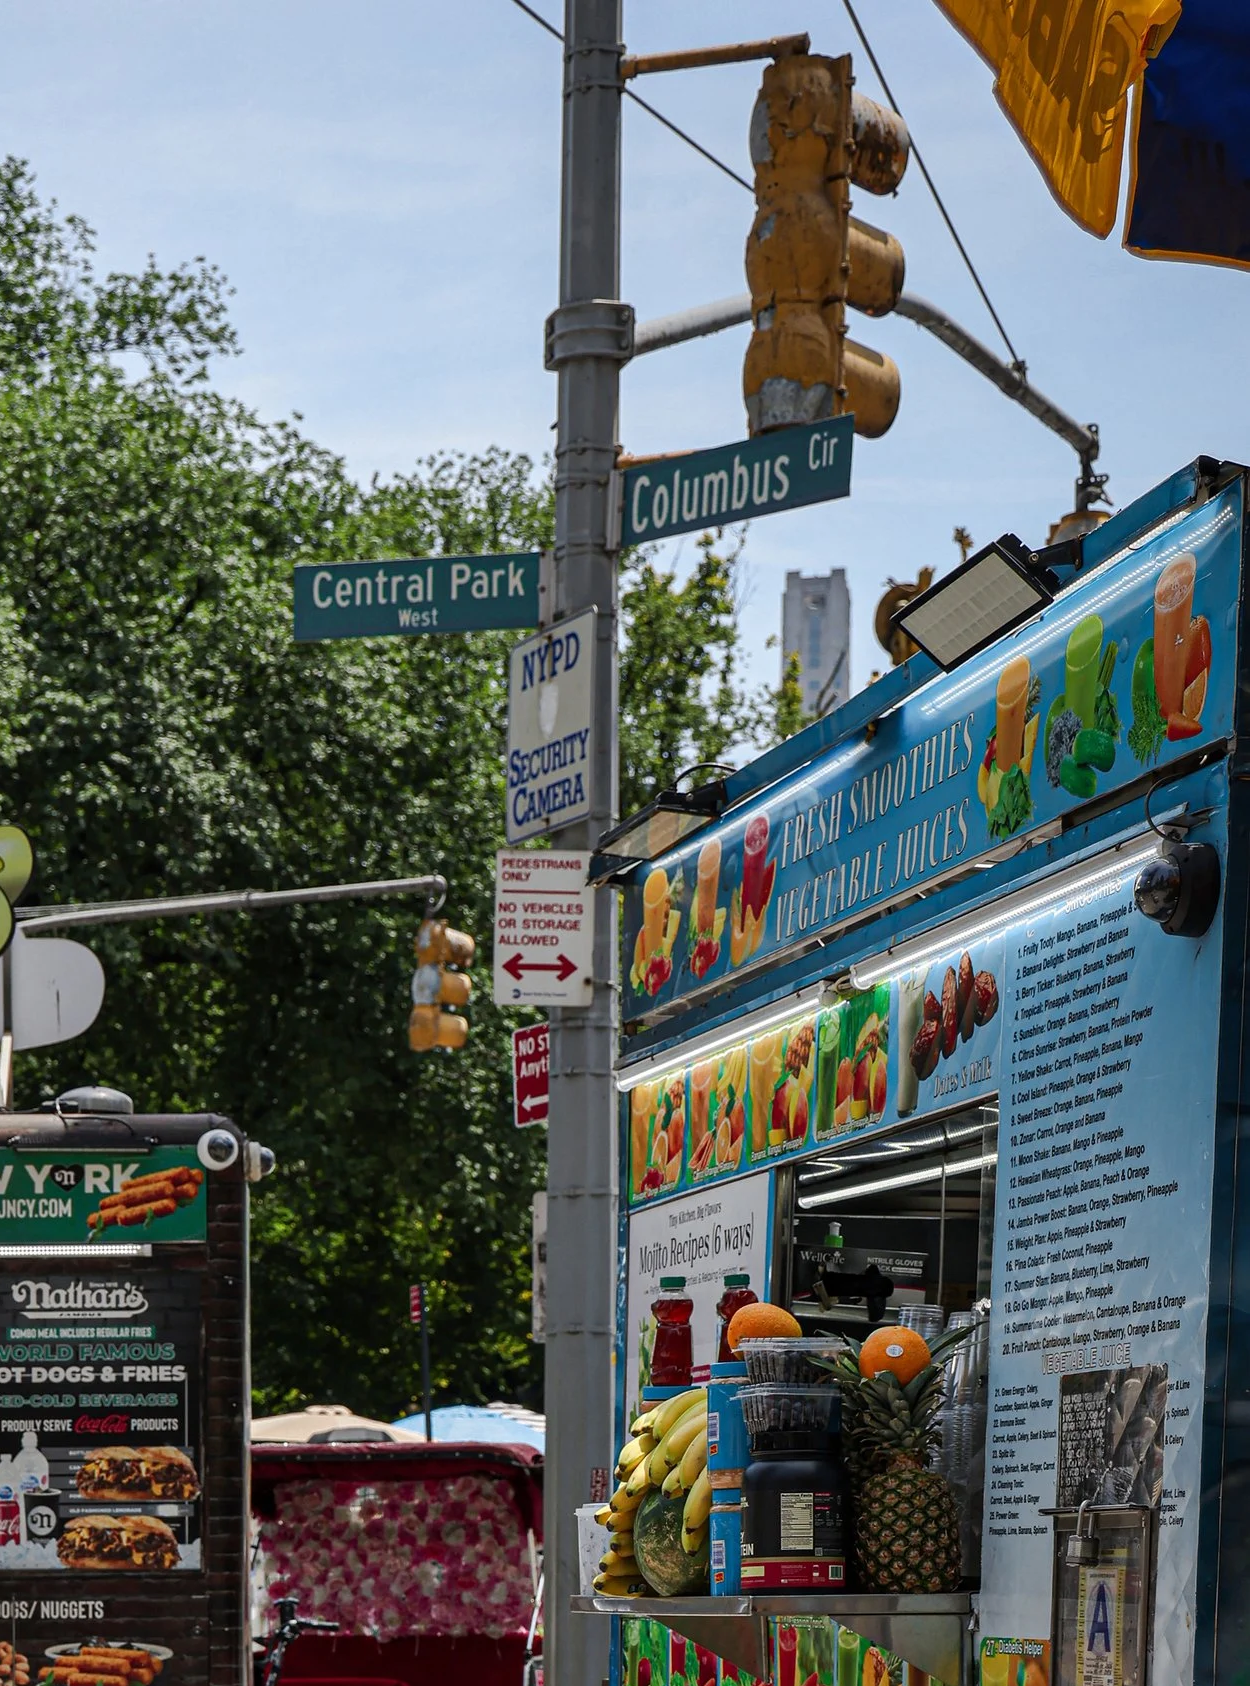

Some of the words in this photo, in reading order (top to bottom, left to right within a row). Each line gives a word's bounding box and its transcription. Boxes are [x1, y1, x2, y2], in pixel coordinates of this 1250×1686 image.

[632, 454, 790, 533] Columbus
[808, 432, 838, 470] Cir
[312, 566, 433, 608] Central
[451, 562, 525, 600] Park
[399, 607, 438, 627] West
[521, 632, 580, 692] NYPD
[510, 728, 589, 788] SECURITY
[513, 772, 584, 826] CAMERA
[781, 789, 843, 869] FRESH
[847, 712, 975, 834] SMOOTHIES
[502, 859, 582, 870] PEDESTRIANS
[502, 872, 531, 881] ONLY
[776, 841, 887, 942] VEGETABLE
[890, 798, 969, 888] JUICES
[499, 903, 516, 913] NO
[522, 904, 583, 914] VEHICLES
[499, 918, 516, 929] OR
[522, 919, 580, 931] STORAGE
[499, 935, 559, 946] ALLOWED
[1022, 963, 1042, 978] Banana
[1067, 941, 1096, 960] Strawberry
[1096, 933, 1106, 948] and
[1108, 927, 1128, 944] Banana
[1022, 986, 1035, 999] Berry
[1083, 960, 1104, 975] Banana,
[1106, 946, 1135, 966] Strawberry
[519, 1037, 535, 1056] NO
[934, 1071, 958, 1098] Dates
[960, 1068, 967, 1088] &
[969, 1056, 992, 1085] Milk
[1018, 1172, 1041, 1187] Hawaiian
[1095, 1148, 1123, 1166] Pineapple,
[1125, 1145, 1145, 1158] Mango
[1018, 1192, 1044, 1208] Passionate
[1046, 1187, 1062, 1201] Peach:
[1103, 1171, 1119, 1186] Peach
[1127, 1166, 1149, 1180] Orange
[1016, 1216, 1033, 1229] Jamba
[1034, 1213, 1050, 1224] Power
[1068, 1204, 1088, 1216] Banana,
[1089, 1198, 1110, 1211] Orange,
[1112, 1190, 1145, 1205] Strawberry,
[1147, 1180, 1178, 1198] Pineapple
[640, 1242, 668, 1278] Mojito
[670, 1232, 710, 1268] Recipes
[712, 1222, 721, 1258] (6
[724, 1212, 753, 1256] ways)
[800, 1251, 845, 1263] WellCare
[867, 1257, 893, 1265] NITRILE
[895, 1258, 923, 1267] GLOVES
[1014, 1279, 1034, 1291] Summer
[1072, 1266, 1098, 1280] Blueberry,
[1100, 1263, 1114, 1274] Lime,
[1117, 1257, 1149, 1271] Strawberry
[11, 1281, 145, 1309] Nathan's
[11, 1328, 36, 1339] COMBO
[38, 1328, 58, 1338] MEAL
[60, 1327, 95, 1338] INCLUDES
[97, 1327, 129, 1338] REGULAR
[131, 1327, 152, 1337] FRIES
[1012, 1342, 1023, 1354] Fruit
[1093, 1328, 1126, 1341] Strawberry,
[1128, 1324, 1149, 1337] Orange
[1158, 1320, 1180, 1332] Banana
[79, 1344, 175, 1361] FAMOUS
[1042, 1347, 1097, 1375] VEGETABLE
[1099, 1343, 1131, 1367] JUICE
[32, 1366, 95, 1383] DOGS
[100, 1366, 116, 1382] &
[123, 1365, 186, 1382] FRIES
[1180, 1380, 1190, 1390] Lime
[80, 1394, 178, 1407] BEVERAGES
[43, 1420, 72, 1431] SERVE
[131, 1419, 178, 1431] PRODUCTS
[40, 1601, 104, 1619] NUGGETS
[1087, 1584, 1110, 1652] A
[986, 1641, 994, 1656] 27
[999, 1640, 1022, 1654] Diabetis
[1024, 1641, 1043, 1658] Helper
